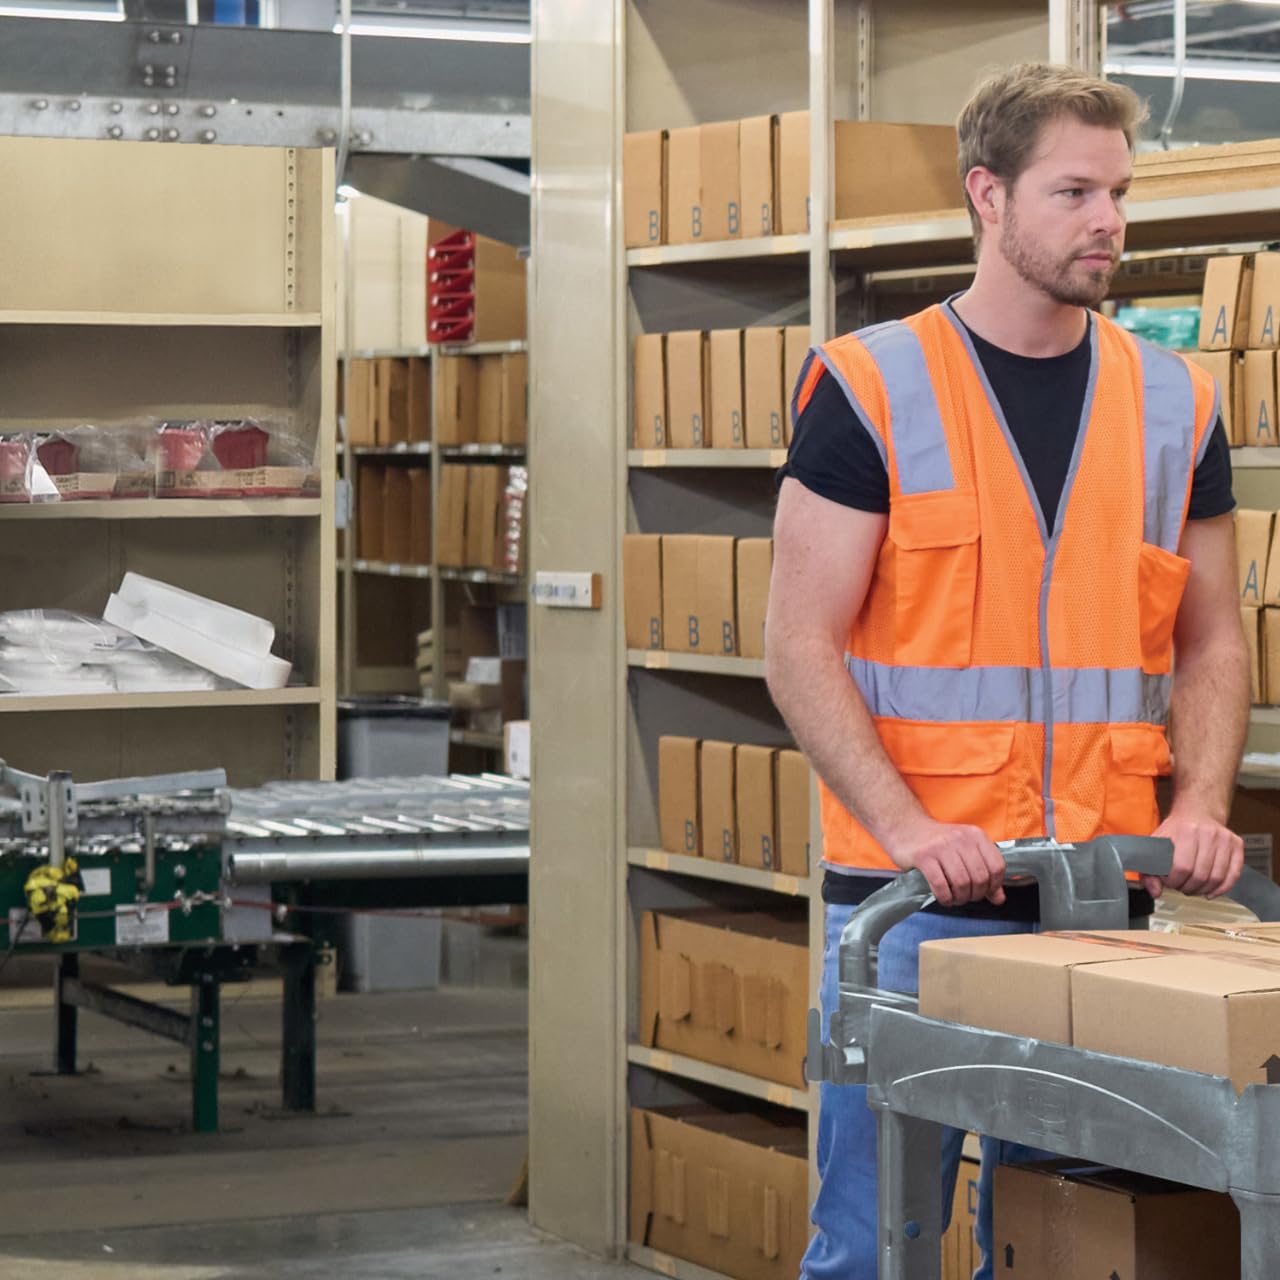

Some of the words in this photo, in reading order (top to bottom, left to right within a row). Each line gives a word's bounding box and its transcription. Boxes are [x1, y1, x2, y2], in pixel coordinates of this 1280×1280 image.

[649, 210, 659, 241] B
[692, 206, 701, 237] B
[728, 202, 739, 234] B
[761, 203, 770, 235] B
[1212, 304, 1227, 345] A
[1261, 304, 1274, 346] A
[654, 415, 663, 446] B
[692, 414, 701, 445] B
[732, 410, 741, 443] B
[771, 411, 781, 444] B
[1257, 399, 1271, 440] A
[1243, 559, 1258, 600] A
[650, 617, 660, 649] B
[688, 615, 700, 647] B
[723, 621, 734, 653] B
[685, 820, 695, 851] B
[723, 829, 732, 862] B
[762, 835, 771, 868] B
